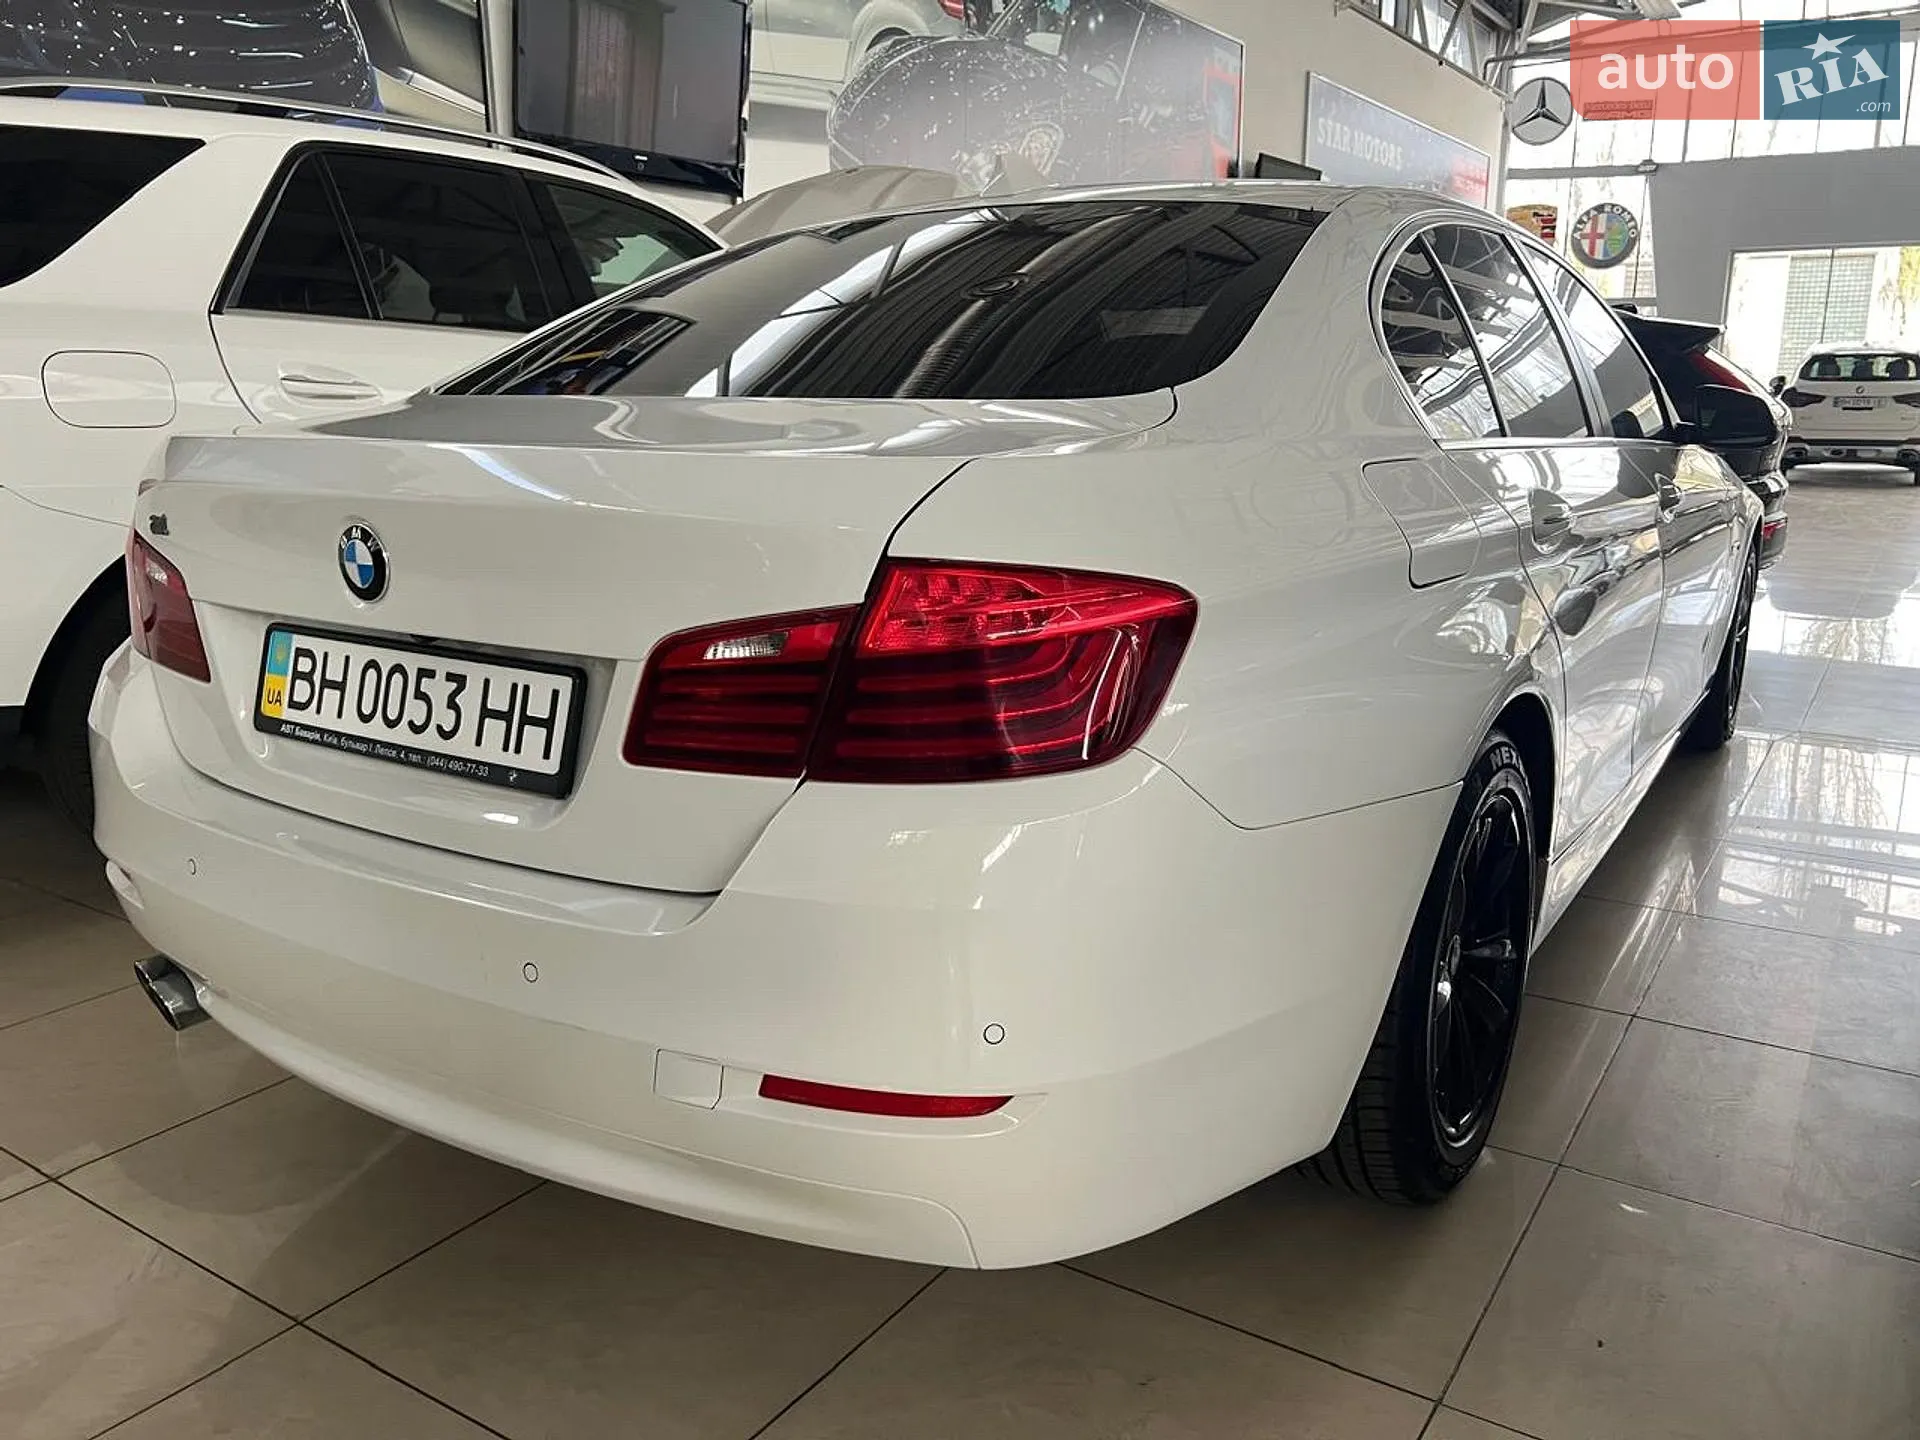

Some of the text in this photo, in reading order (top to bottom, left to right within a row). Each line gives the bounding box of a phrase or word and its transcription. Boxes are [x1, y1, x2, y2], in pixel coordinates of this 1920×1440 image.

[1317, 117, 1403, 171] STAR MOTORS
[1603, 203, 1638, 238] ROMEO
[340, 526, 381, 552] BMW
[267, 688, 282, 706] UA
[287, 646, 561, 760] BH 0053 HH
